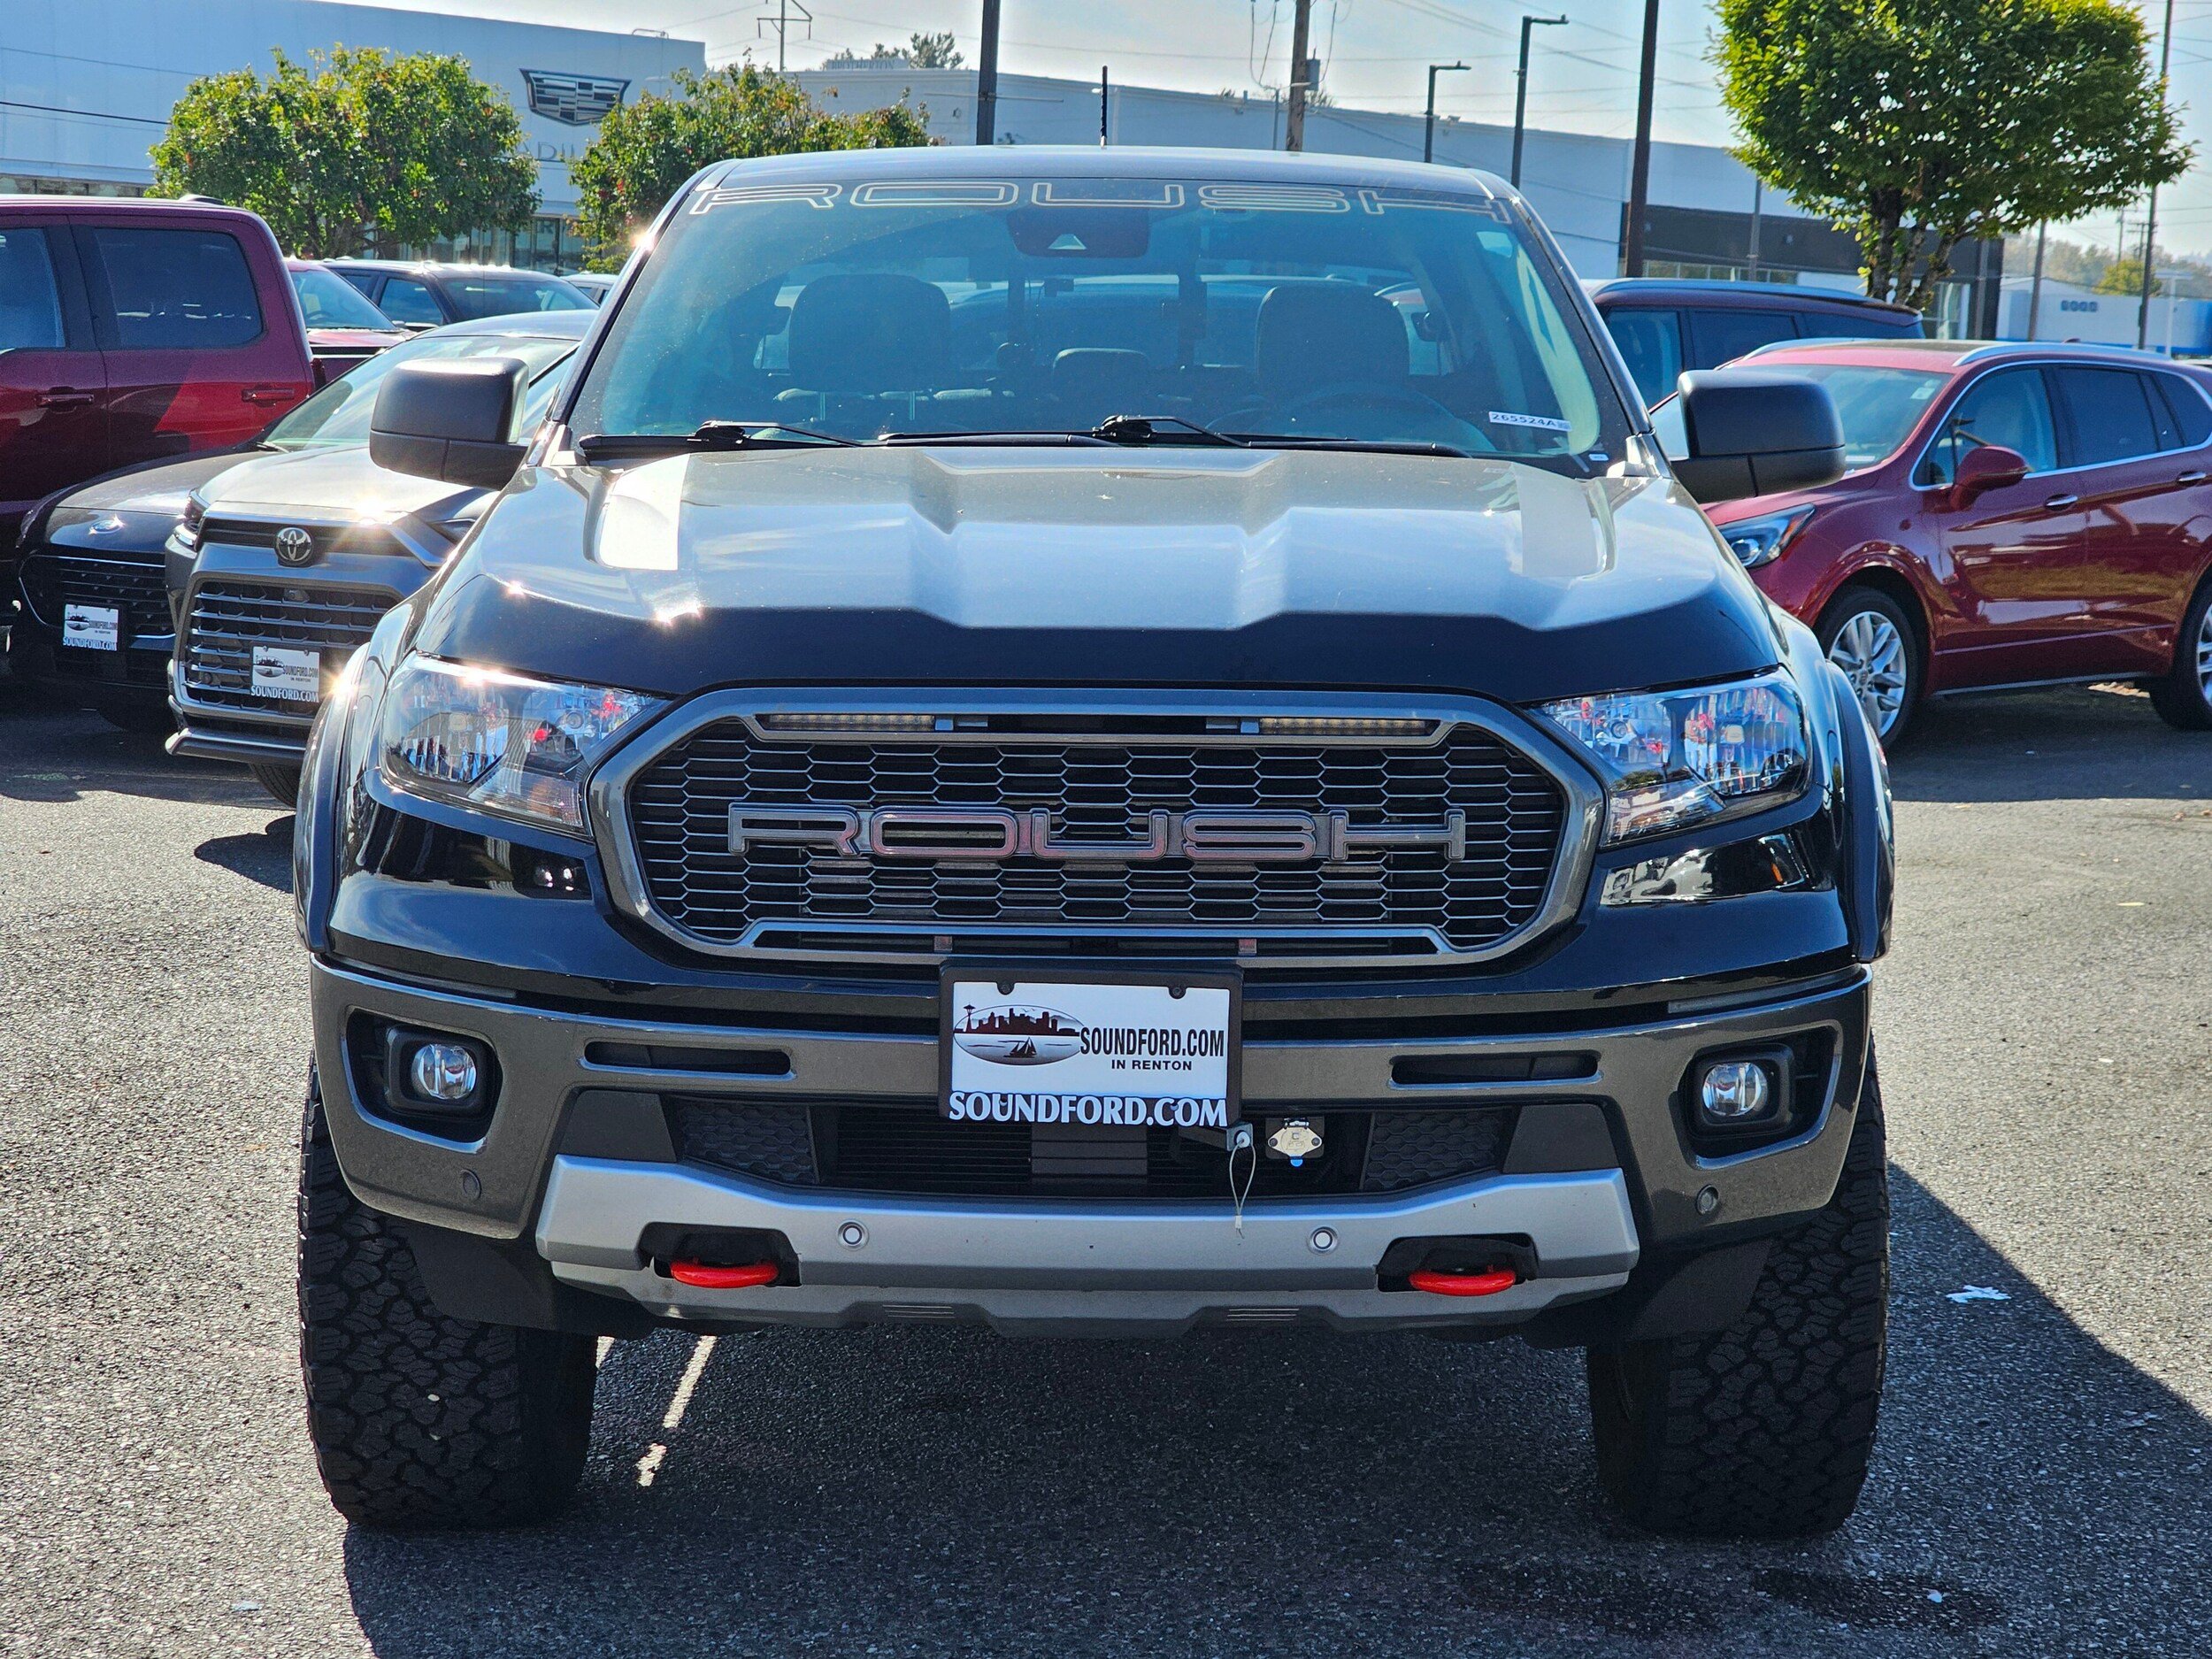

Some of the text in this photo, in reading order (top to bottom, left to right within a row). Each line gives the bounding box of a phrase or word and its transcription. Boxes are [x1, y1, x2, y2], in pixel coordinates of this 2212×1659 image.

[689, 180, 1512, 224] ROUSH
[1492, 412, 1556, 427] 265524A
[63, 636, 118, 651] SOUNDFORD.COM
[250, 685, 319, 703] SOUNDFORD.COM
[727, 801, 1466, 863] ROUSH
[1079, 1026, 1225, 1057] SOUNDFORD.COM
[1110, 1059, 1193, 1071] IN RENTON
[949, 1090, 1228, 1128] SOUNDFORD.COM
